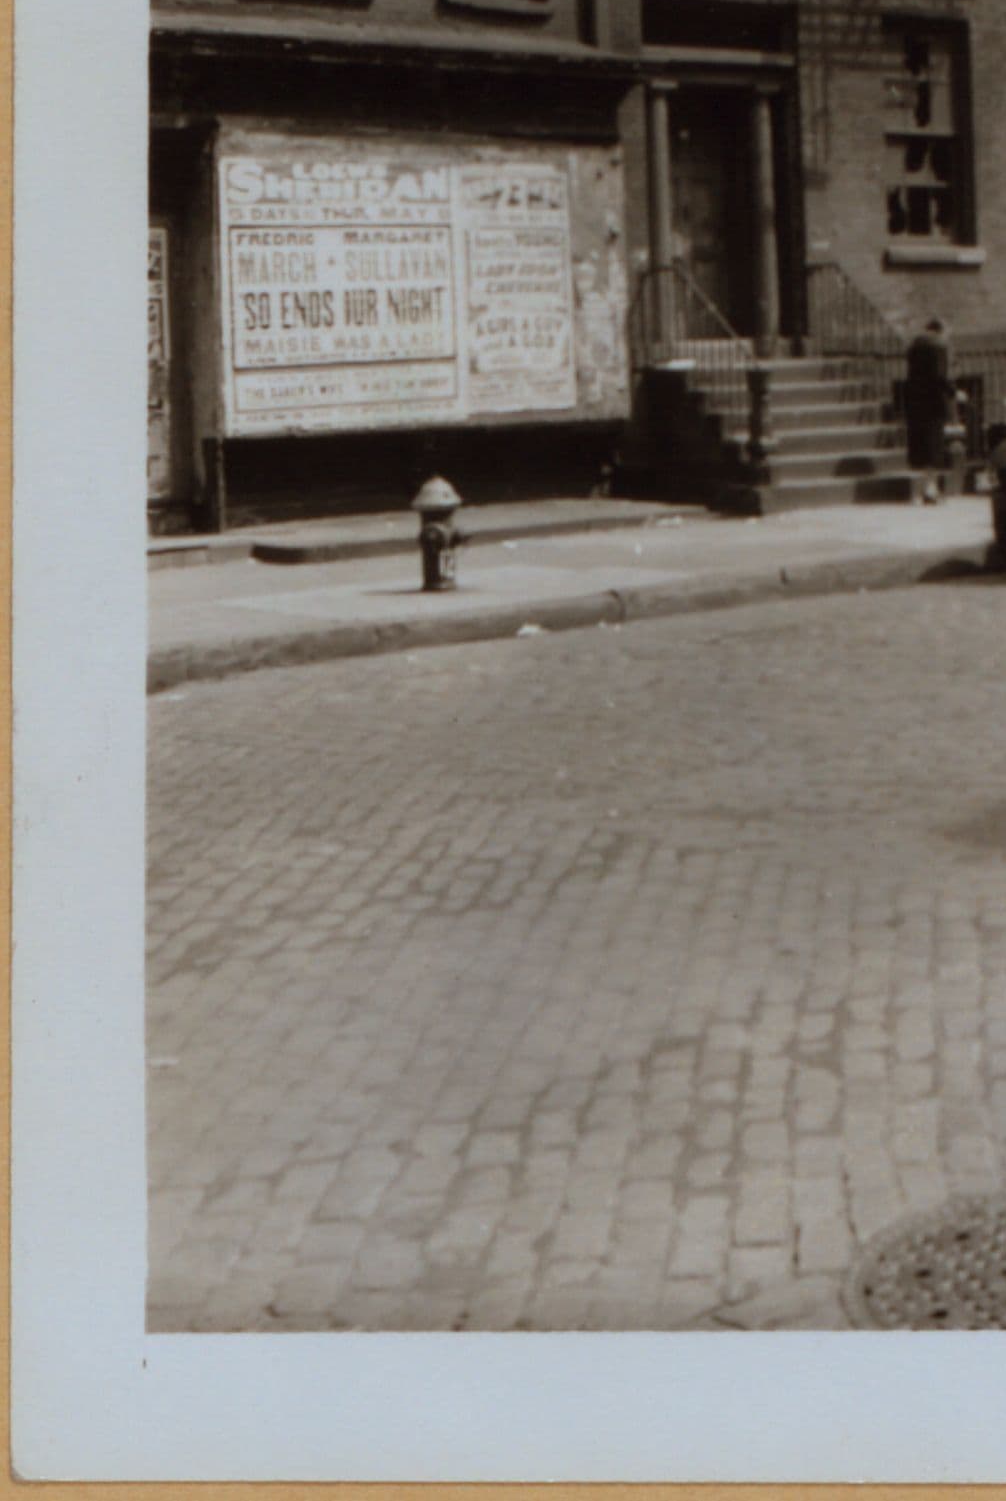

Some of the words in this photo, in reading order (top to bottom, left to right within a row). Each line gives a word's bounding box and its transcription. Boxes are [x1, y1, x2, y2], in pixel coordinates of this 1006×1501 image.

[226, 161, 449, 204] SHERIDAN
[379, 206, 427, 219] MAY
[236, 232, 315, 246] FREDRIC
[343, 230, 445, 244] MARGARET
[237, 251, 318, 284] MARCH
[344, 250, 447, 281] SULLAVAN
[243, 291, 271, 331] SO
[280, 289, 334, 330] ENDS
[387, 285, 446, 325] NIGHT
[245, 336, 321, 354] MAISIE
[333, 333, 372, 350] WAS
[380, 332, 390, 348] A
